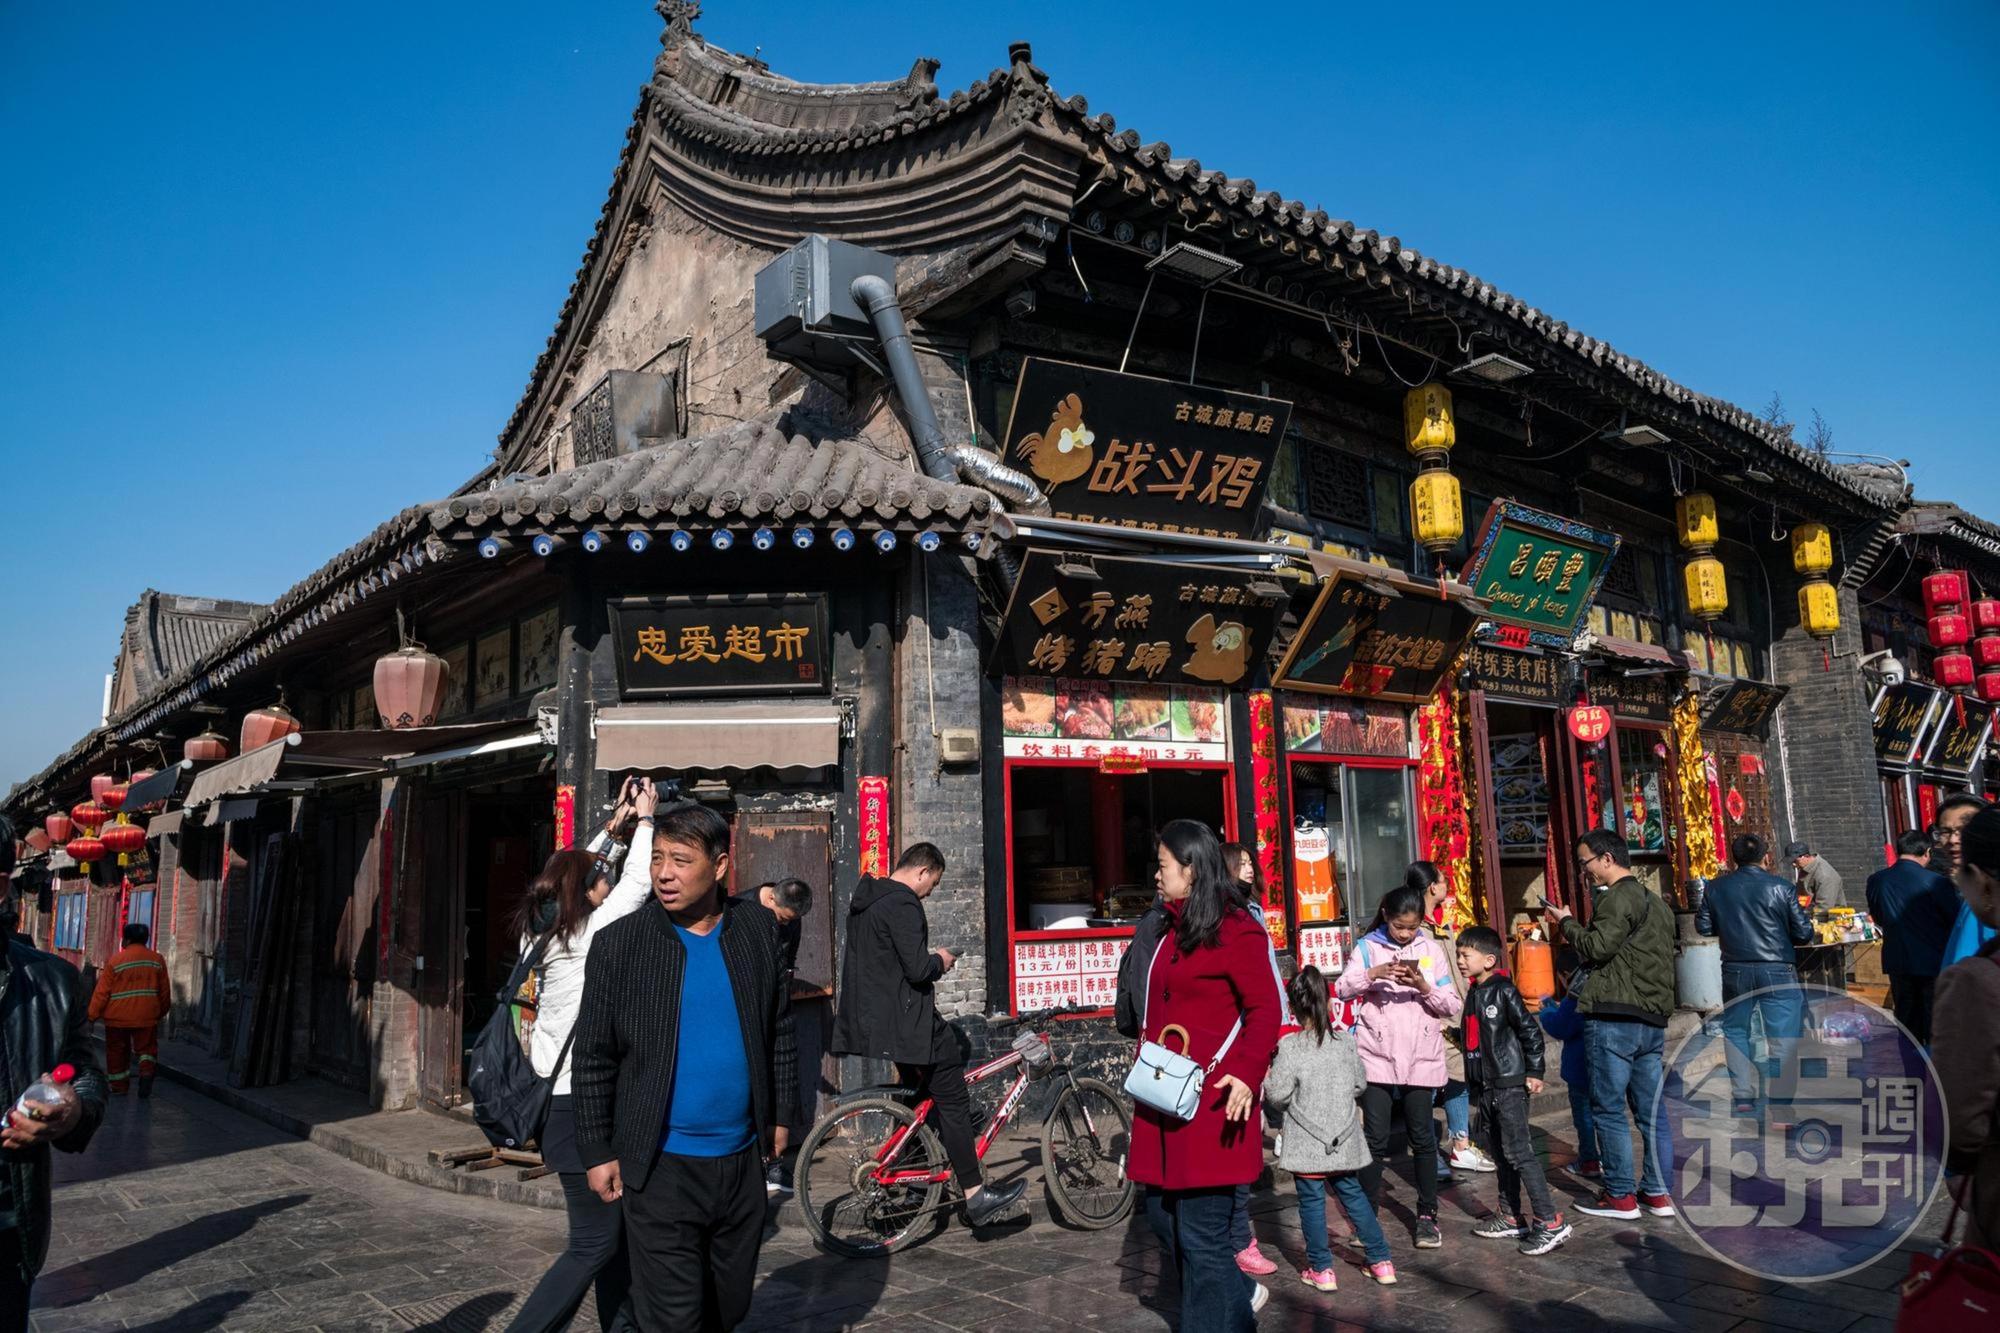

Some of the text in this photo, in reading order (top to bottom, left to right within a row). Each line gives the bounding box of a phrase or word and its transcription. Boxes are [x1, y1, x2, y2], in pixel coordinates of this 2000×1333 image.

[1175, 401, 1275, 435] 古城旗舰店
[1087, 438, 1262, 509] 战斗鸡
[1486, 581, 1525, 608] Chang
[1544, 595, 1569, 619] tang
[633, 621, 810, 665] 忠爱超市
[1028, 632, 1172, 679] 烤猪蹄
[1021, 743, 1204, 761] 饮料套餐加3元
[1017, 945, 1077, 960] 招牌战斗鸡排
[1019, 960, 1077, 972] 13元/份
[1020, 995, 1078, 1009] 15元/份
